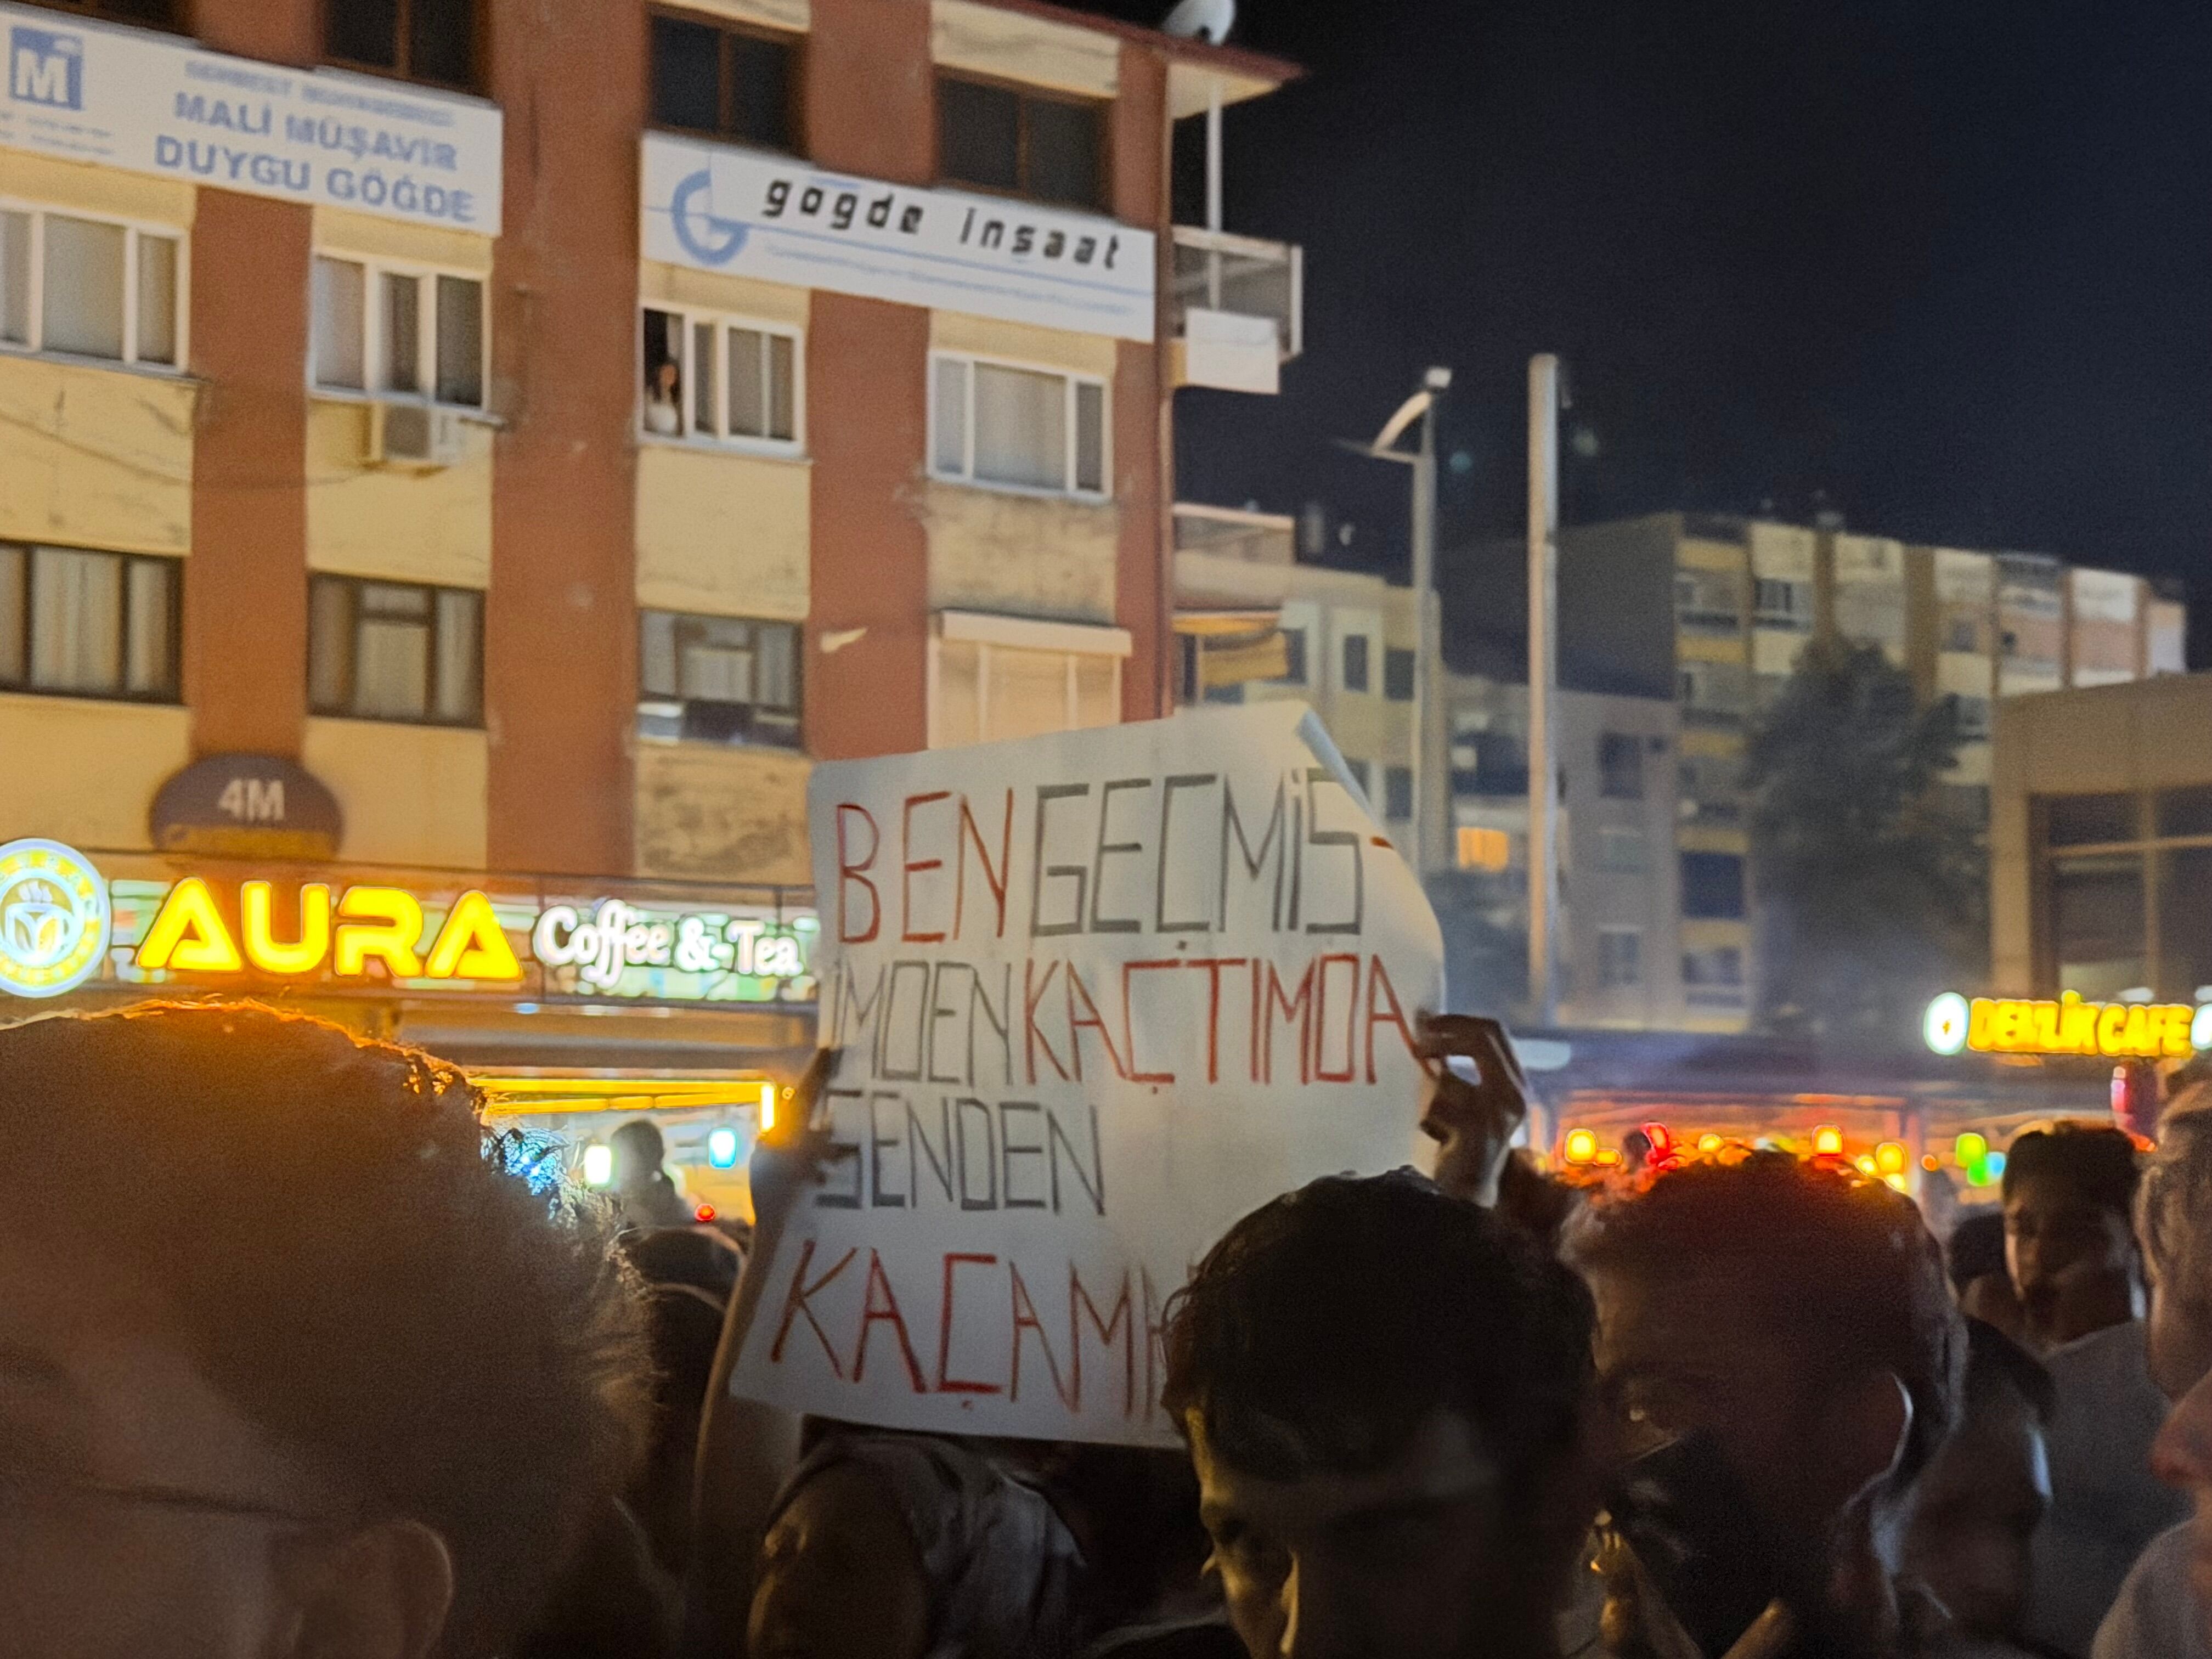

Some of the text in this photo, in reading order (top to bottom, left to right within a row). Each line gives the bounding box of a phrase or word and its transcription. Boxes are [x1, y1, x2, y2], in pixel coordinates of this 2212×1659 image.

[155, 134, 311, 192] DUYGU
[218, 777, 285, 822] 4M
[836, 787, 1014, 945] BEN
[136, 878, 524, 981] AURA
[533, 899, 672, 989] Coffee
[726, 919, 804, 978] Tea
[2098, 1003, 2194, 1057] CAFE
